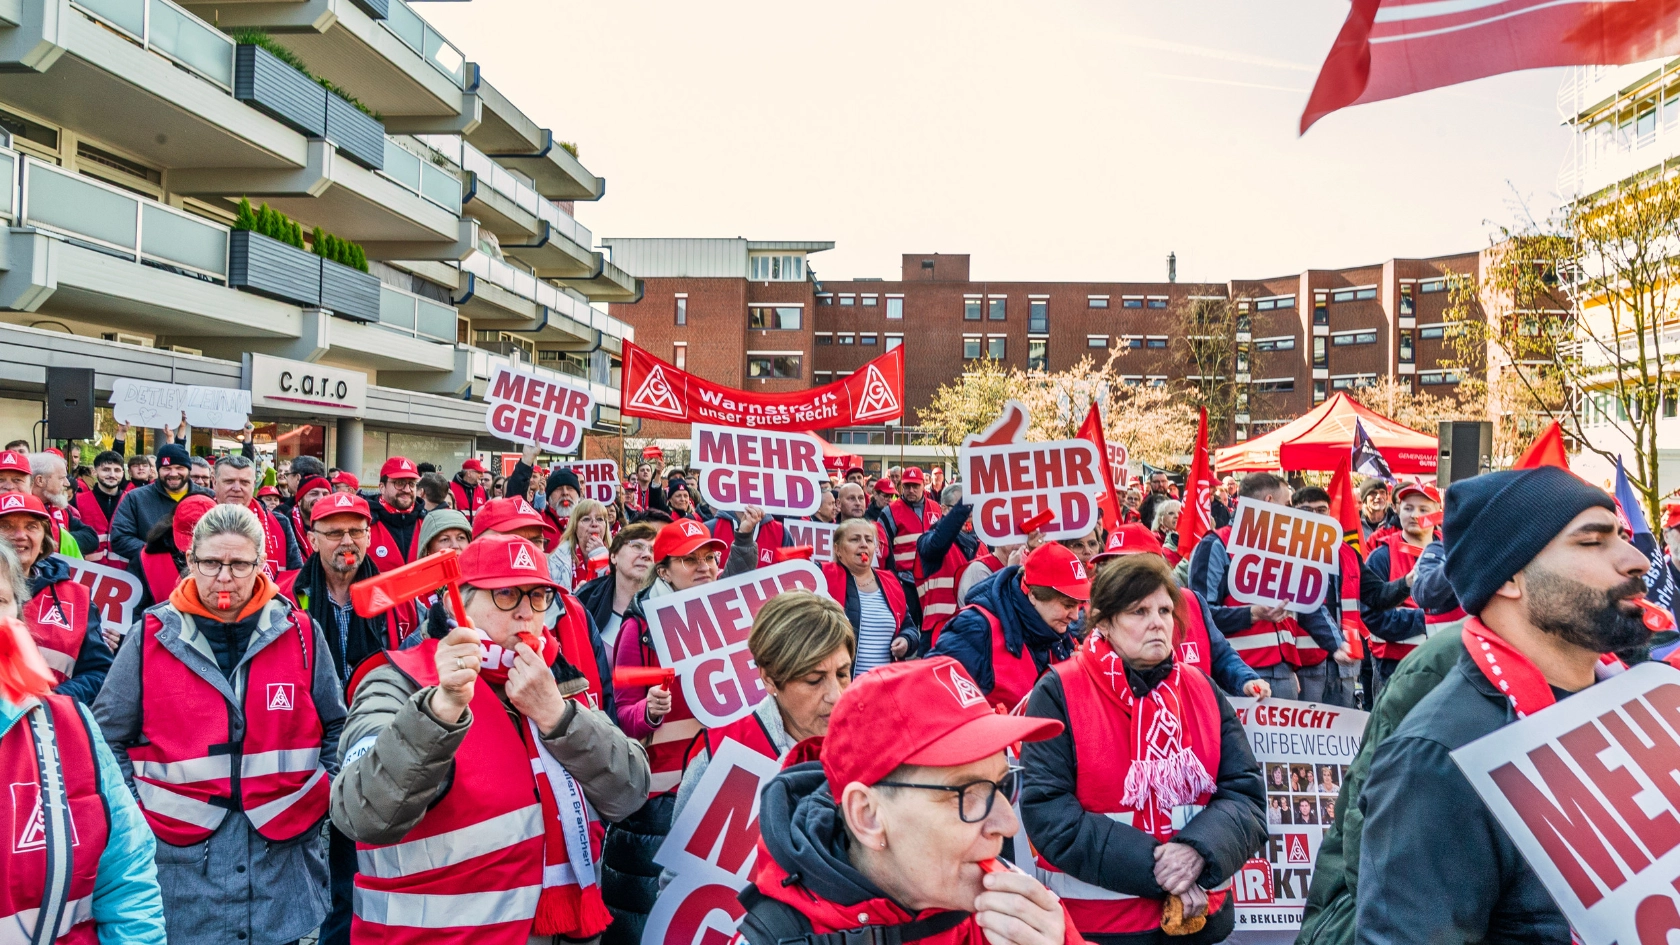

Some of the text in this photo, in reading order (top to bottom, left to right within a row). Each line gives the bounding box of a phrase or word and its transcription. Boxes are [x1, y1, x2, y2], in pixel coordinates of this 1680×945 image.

[280, 371, 347, 399] c.a.r.o
[492, 370, 589, 421] MEHR
[492, 404, 576, 448] GELD
[699, 407, 742, 423] unser
[746, 414, 790, 427] gutes
[699, 430, 819, 473] MEHR
[970, 447, 1095, 495] MEHR
[708, 468, 814, 509] GELD
[980, 492, 1090, 537] GELD
[1235, 506, 1337, 565] MEHR
[1235, 554, 1323, 605] GELD
[1255, 705, 1340, 729] GESICHT
[1253, 732, 1361, 757] RIFBEWEGUN
[573, 801, 591, 867] Branchen
[1251, 914, 1302, 924] BEKLEIDU
